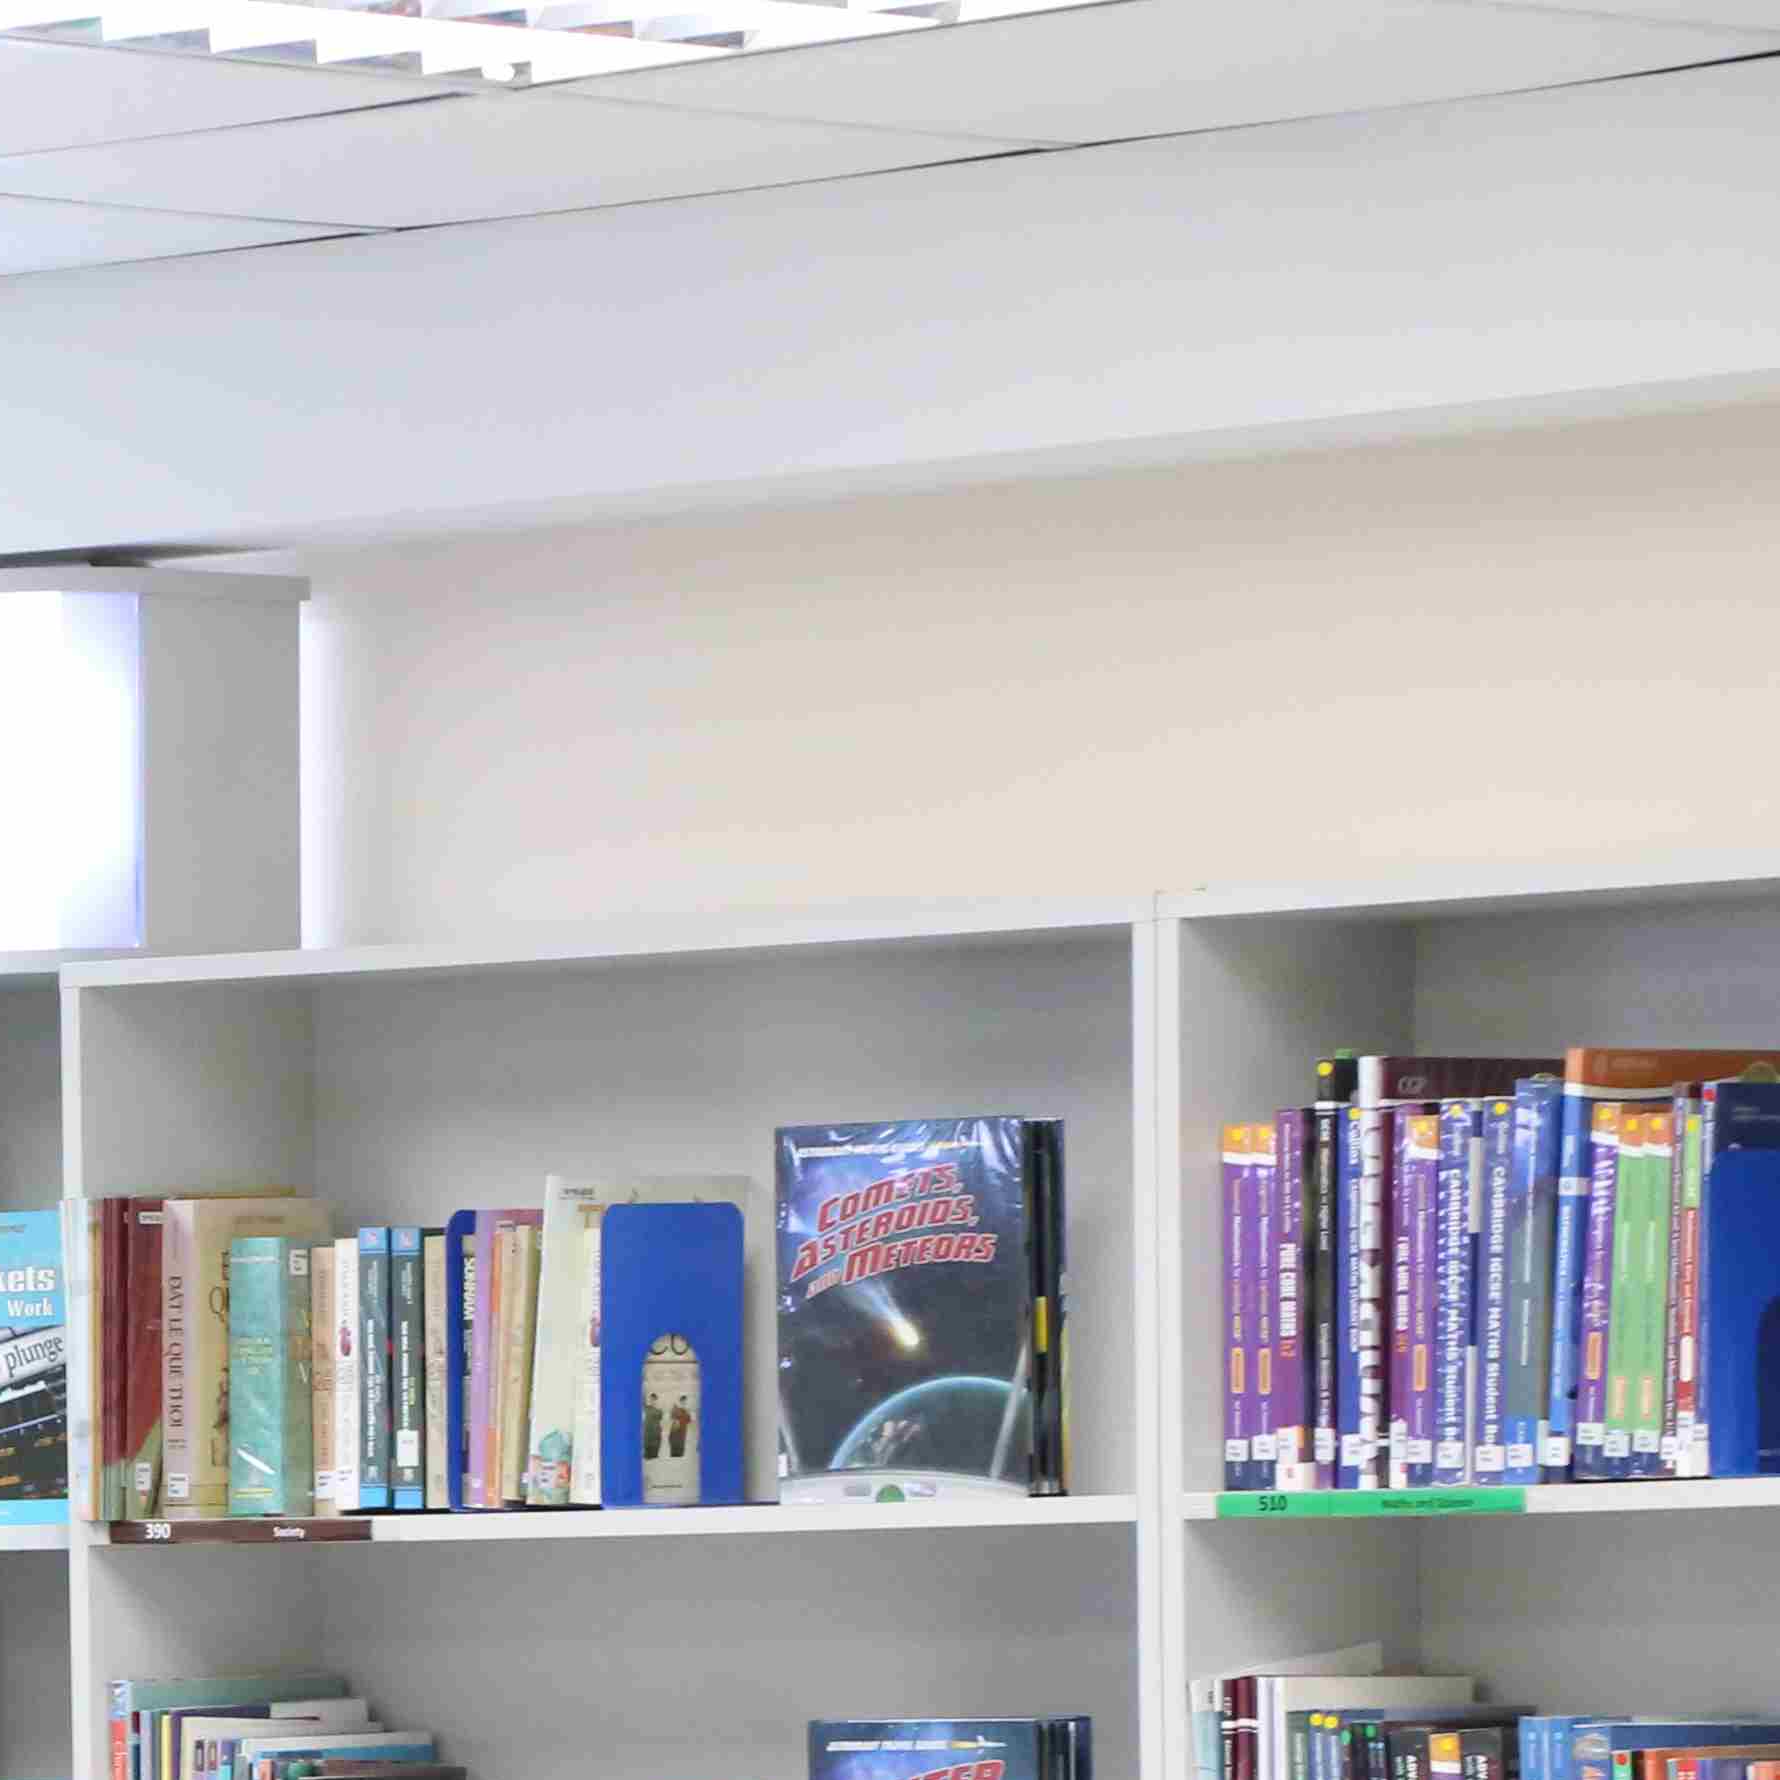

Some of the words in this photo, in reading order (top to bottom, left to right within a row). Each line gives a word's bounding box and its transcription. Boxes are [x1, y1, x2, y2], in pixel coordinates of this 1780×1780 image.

[1487, 1167, 1505, 1254] CAMBRIDGE
[840, 1233, 999, 1286] METEORS
[6, 1298, 54, 1318] Work
[1485, 1308, 1503, 1358] MATHS
[6, 1335, 64, 1378] plunge
[1484, 1363, 1501, 1421] Student
[144, 1523, 172, 1539] 390
